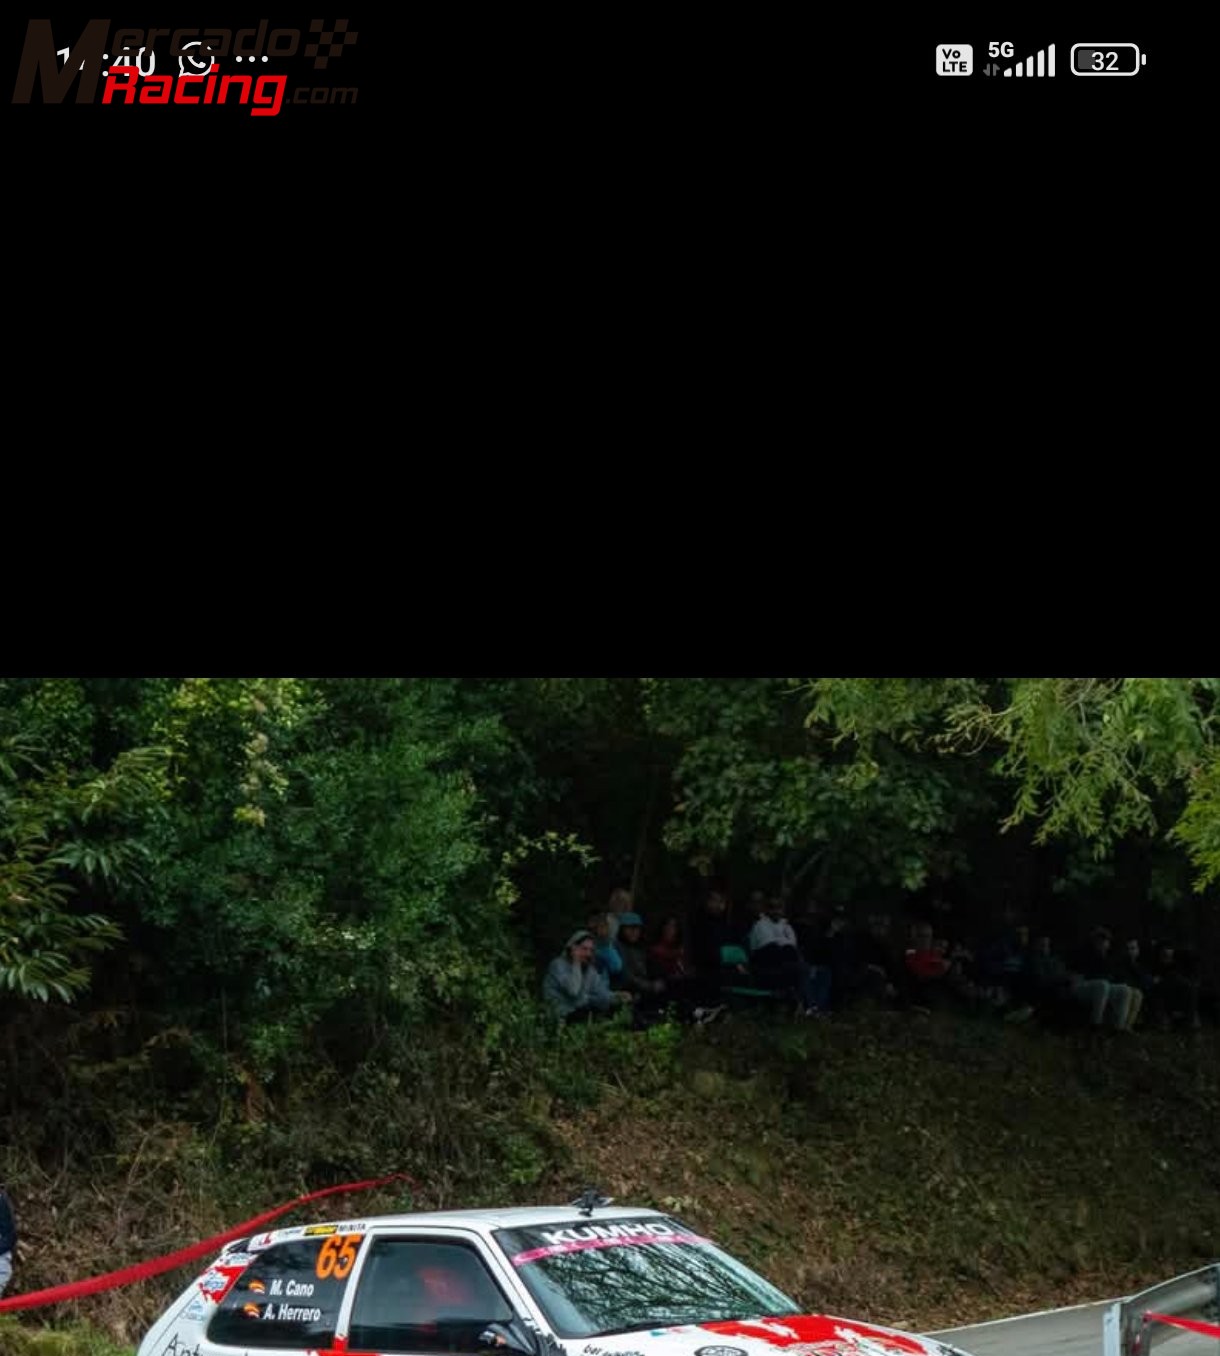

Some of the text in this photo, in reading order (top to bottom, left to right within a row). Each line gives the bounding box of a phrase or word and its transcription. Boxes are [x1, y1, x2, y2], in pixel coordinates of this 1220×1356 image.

[942, 48, 961, 59] Vo
[988, 41, 1014, 58] 5G
[942, 61, 968, 73] LTE
[1091, 51, 1119, 71] 32
[541, 1222, 676, 1245] KUMHO
[315, 1233, 362, 1280] 65
[269, 1280, 315, 1297] M. Cano
[263, 1304, 321, 1321] A. Herrero
